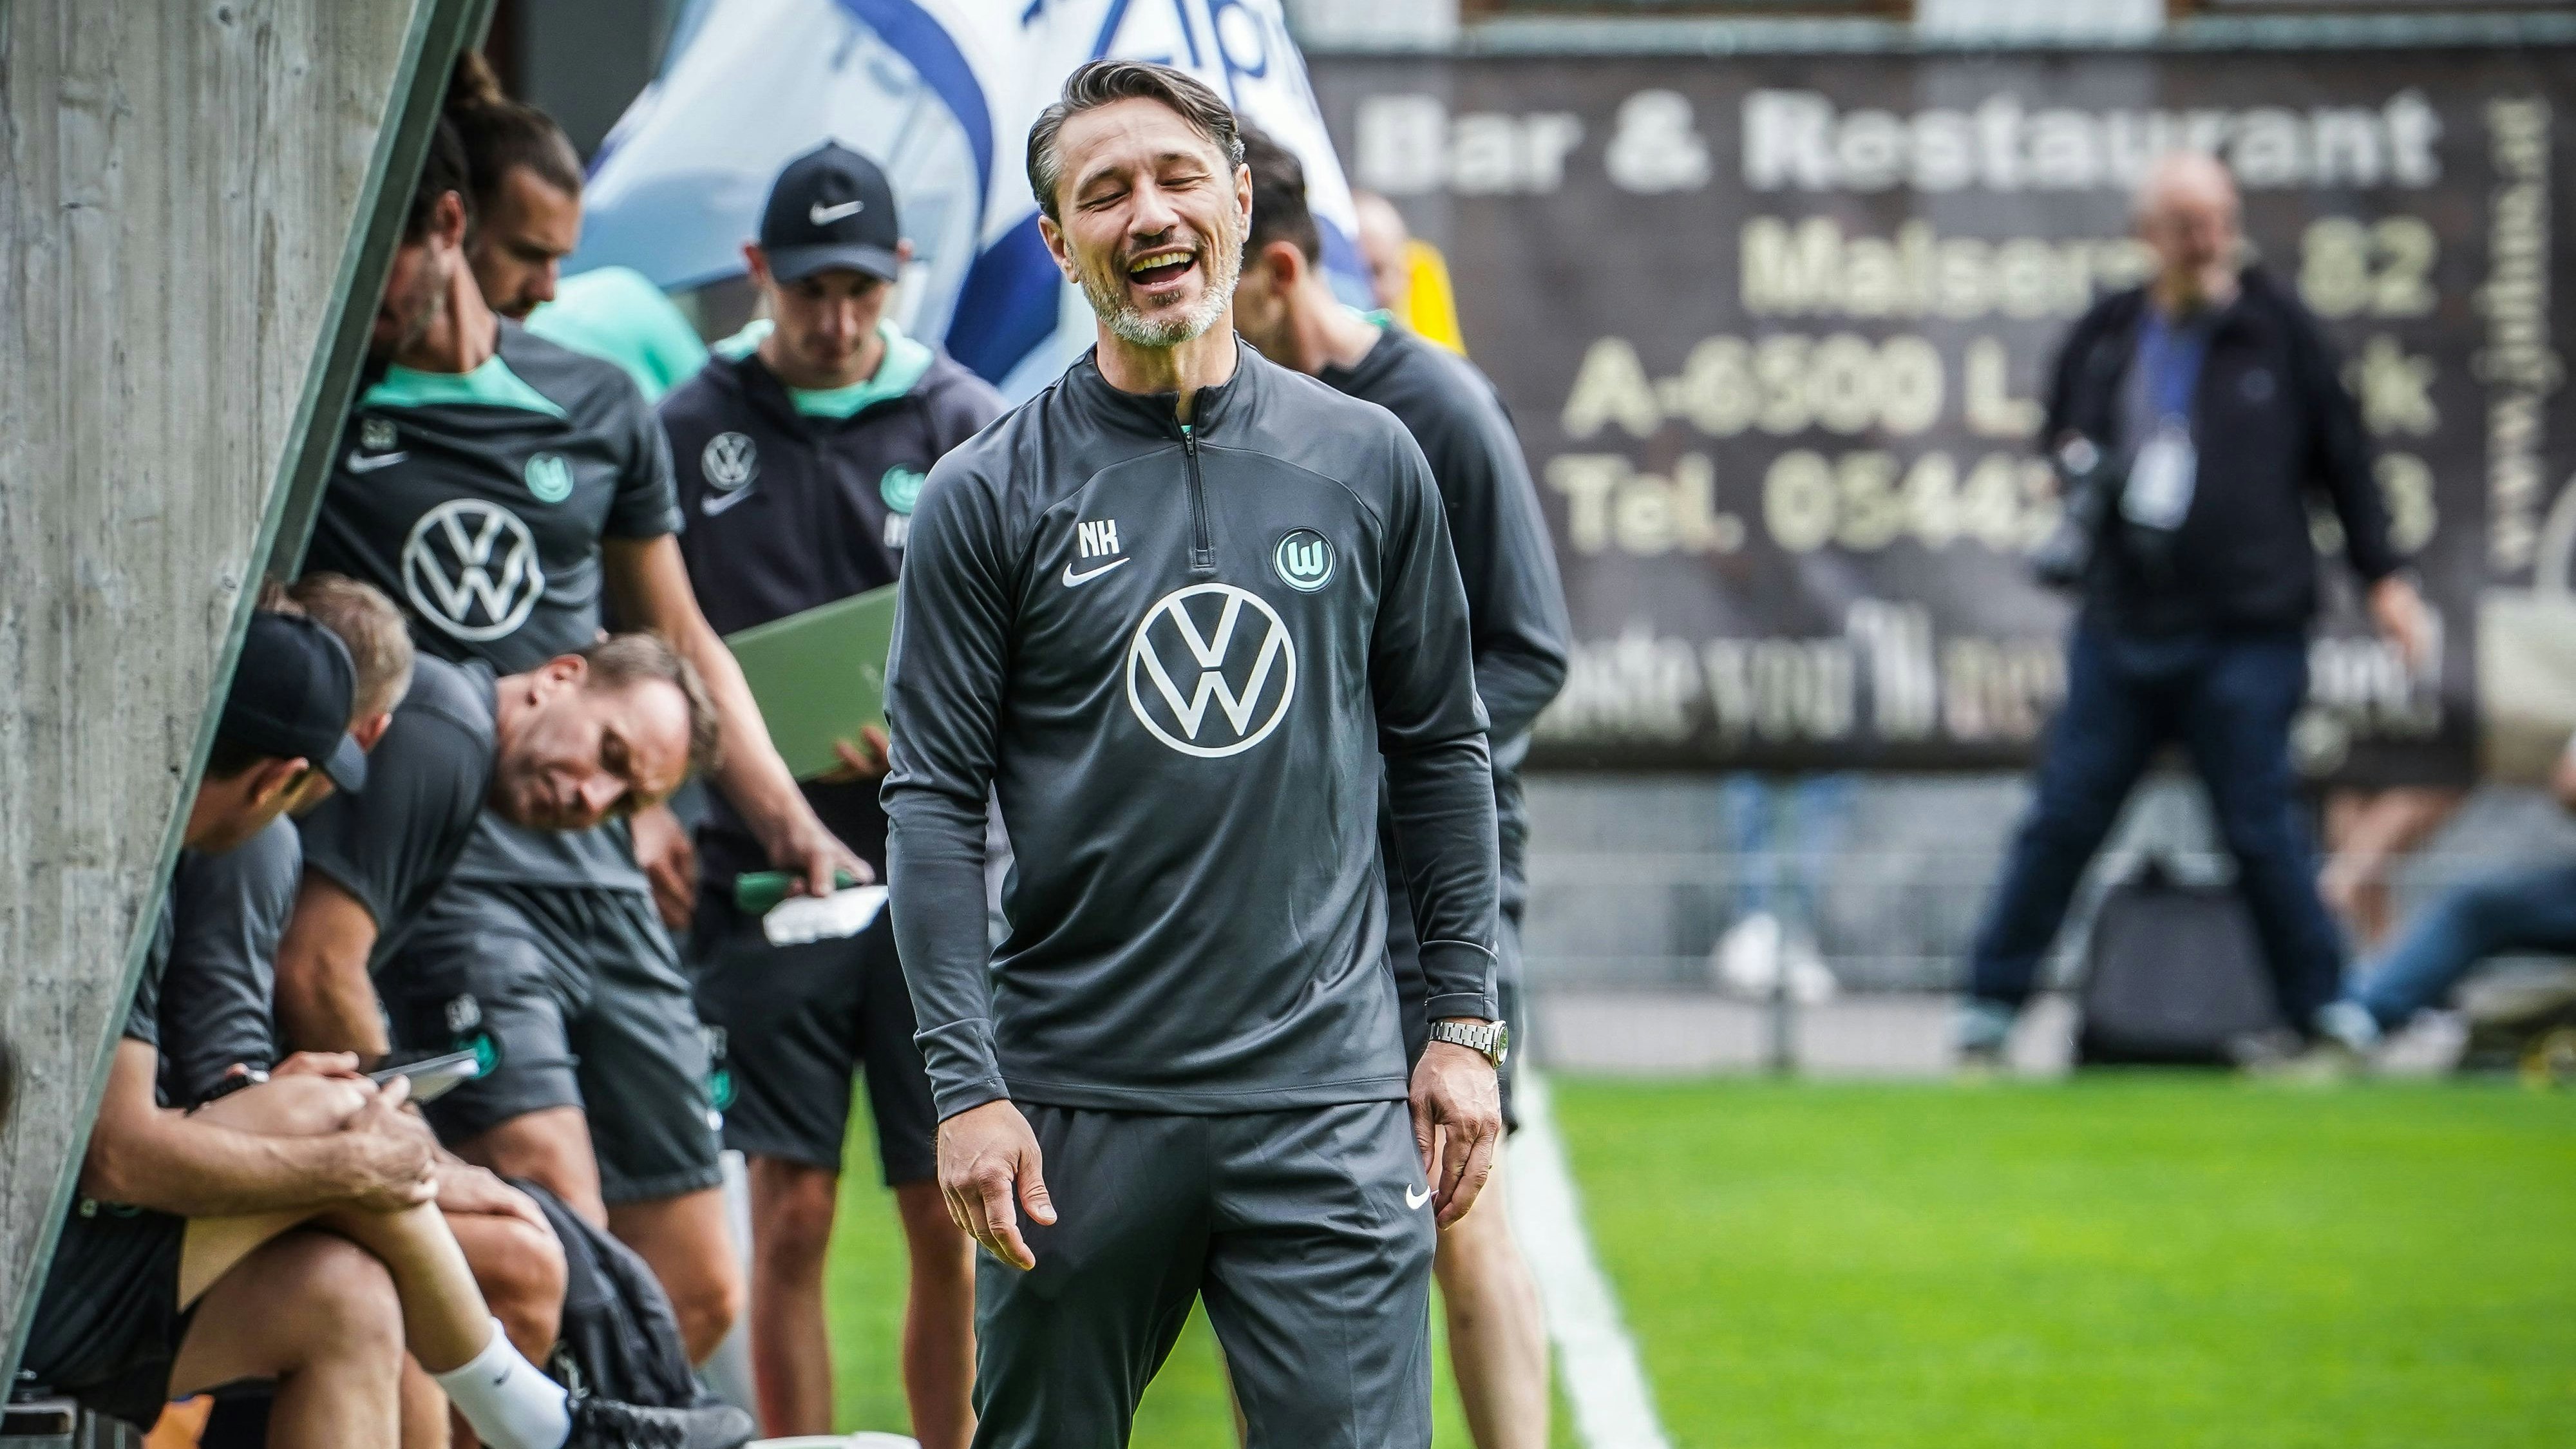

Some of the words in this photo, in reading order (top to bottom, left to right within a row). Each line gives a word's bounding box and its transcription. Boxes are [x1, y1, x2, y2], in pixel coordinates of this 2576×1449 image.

[1356, 94, 1581, 194] Bar
[1607, 89, 1710, 194] &
[1740, 88, 2439, 191] Restaurant
[2300, 216, 2438, 319] 82
[1077, 519, 1119, 558] NK
[1549, 451, 1744, 554] Tel.
[1127, 582, 1296, 758] VW
